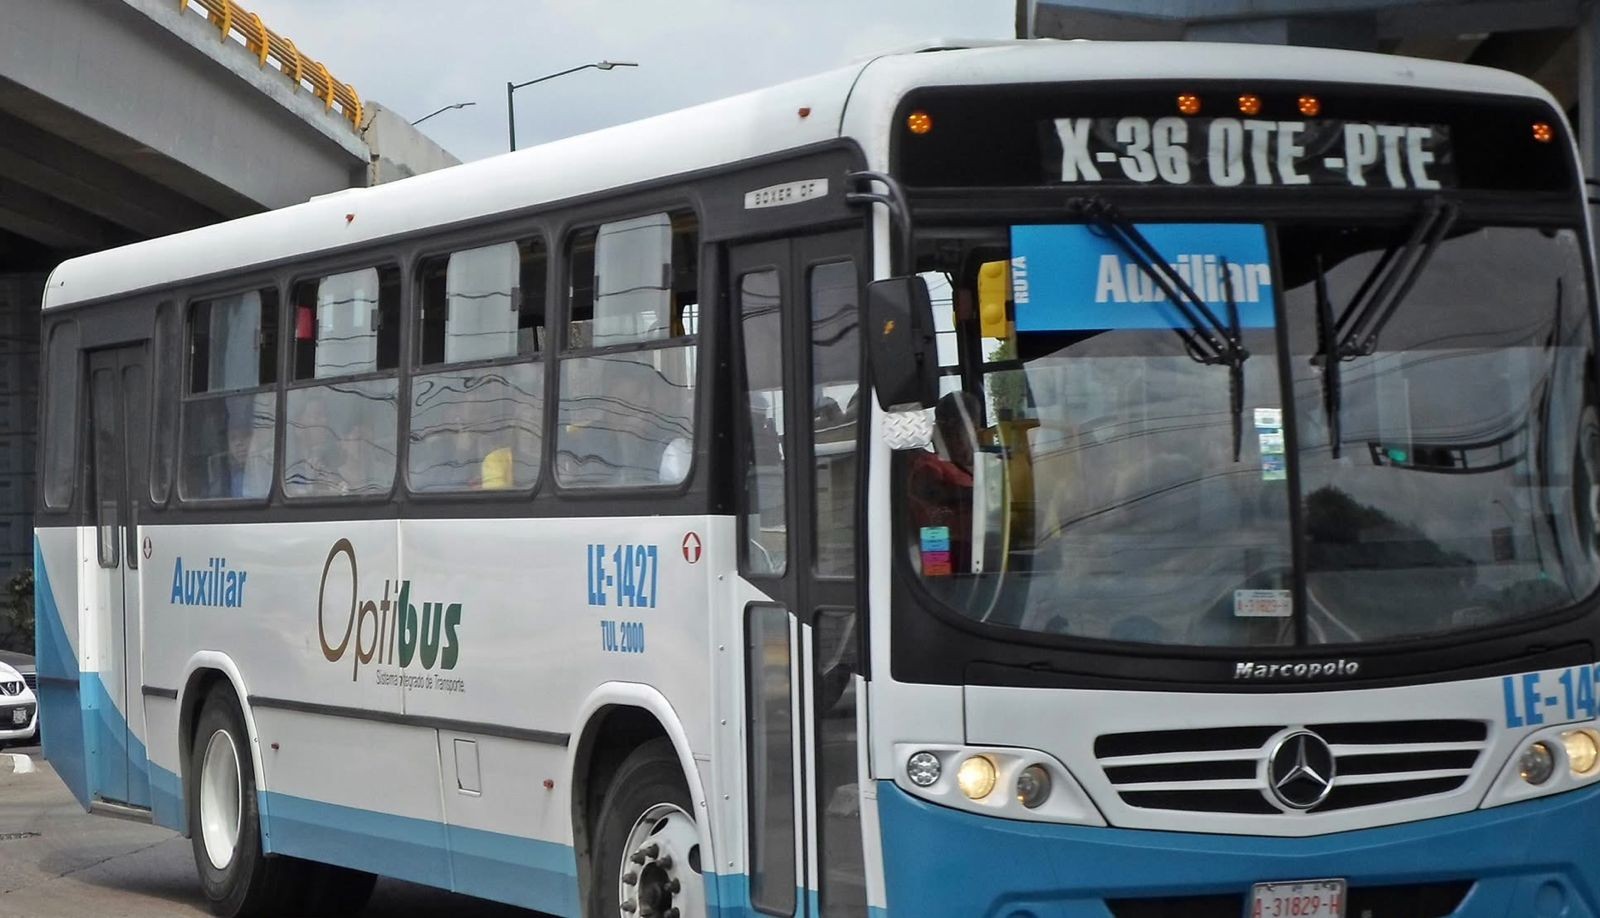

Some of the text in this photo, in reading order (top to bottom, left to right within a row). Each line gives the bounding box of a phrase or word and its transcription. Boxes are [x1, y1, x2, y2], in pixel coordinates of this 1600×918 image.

[1054, 117, 1191, 183] X-36
[1208, 117, 1311, 187] OTE
[755, 187, 792, 206] BOXER
[1011, 256, 1030, 304] RUTA
[1095, 254, 1271, 303] Auxiliar
[170, 556, 247, 608] Auxiliar
[587, 544, 658, 608] LE-1427
[318, 538, 463, 682] Optibus
[600, 620, 645, 653] TUL 2000
[376, 669, 398, 686] Sistema
[398, 674, 424, 691] ntegrado
[425, 675, 433, 689] de
[1234, 659, 1359, 679] Marcopolo
